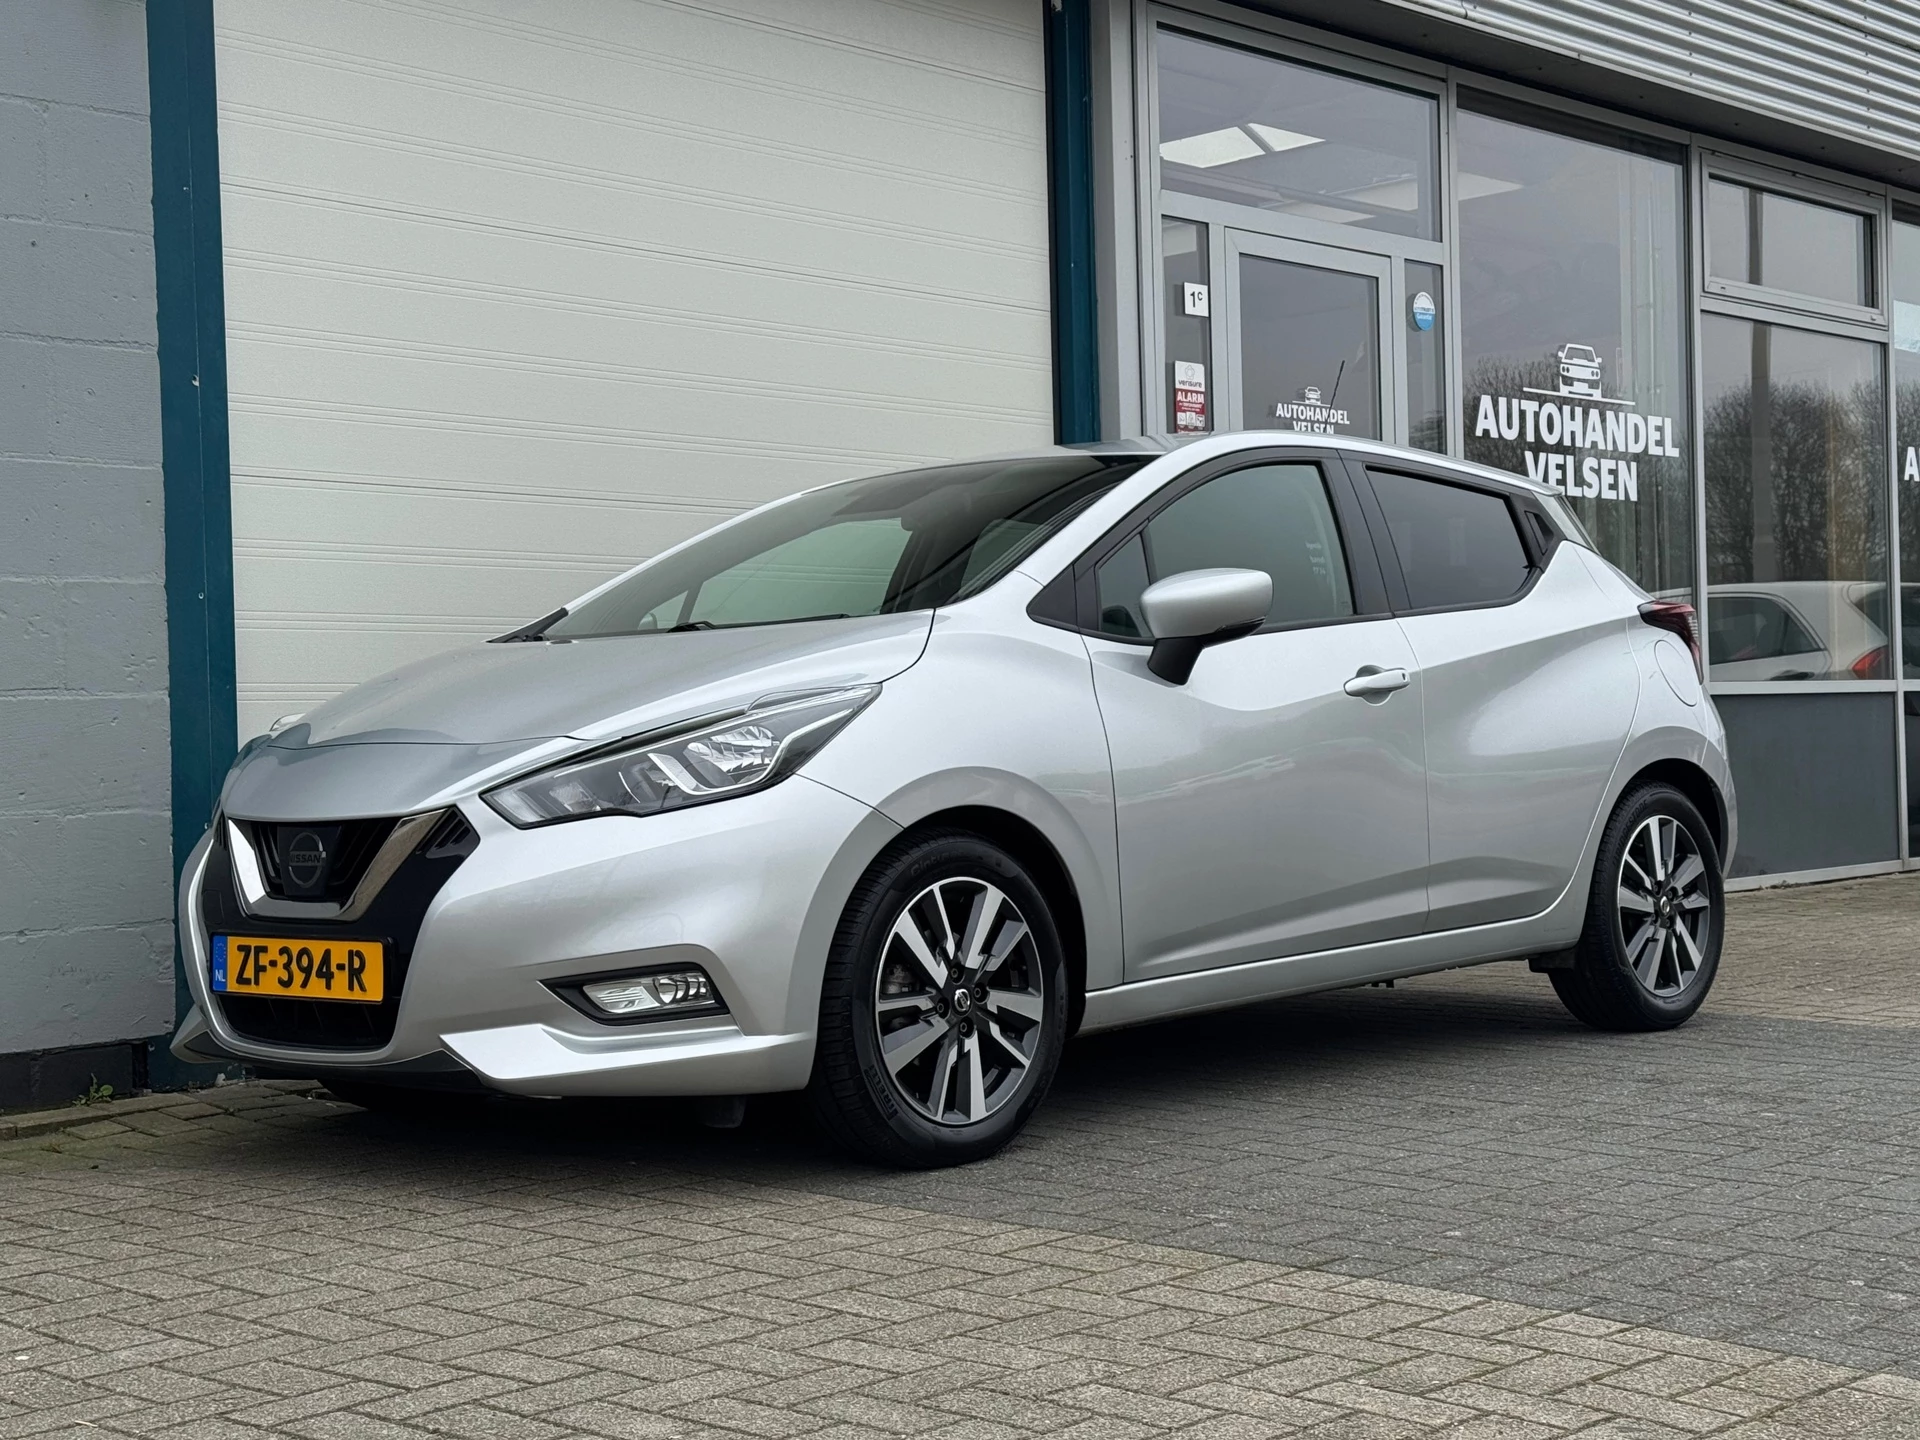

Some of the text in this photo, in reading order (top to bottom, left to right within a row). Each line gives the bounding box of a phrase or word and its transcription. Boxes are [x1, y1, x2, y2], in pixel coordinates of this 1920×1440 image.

[1177, 391, 1205, 403] ALARM
[1178, 379, 1203, 388] verisure
[1276, 402, 1350, 425] AUTOHANDEL
[1475, 394, 1680, 458] AUTOHANDEL
[1524, 450, 1638, 502] VELSEN
[1904, 446, 1920, 482] A
[290, 853, 321, 864] NISSAN
[215, 944, 367, 992] NL ZF-394-R
